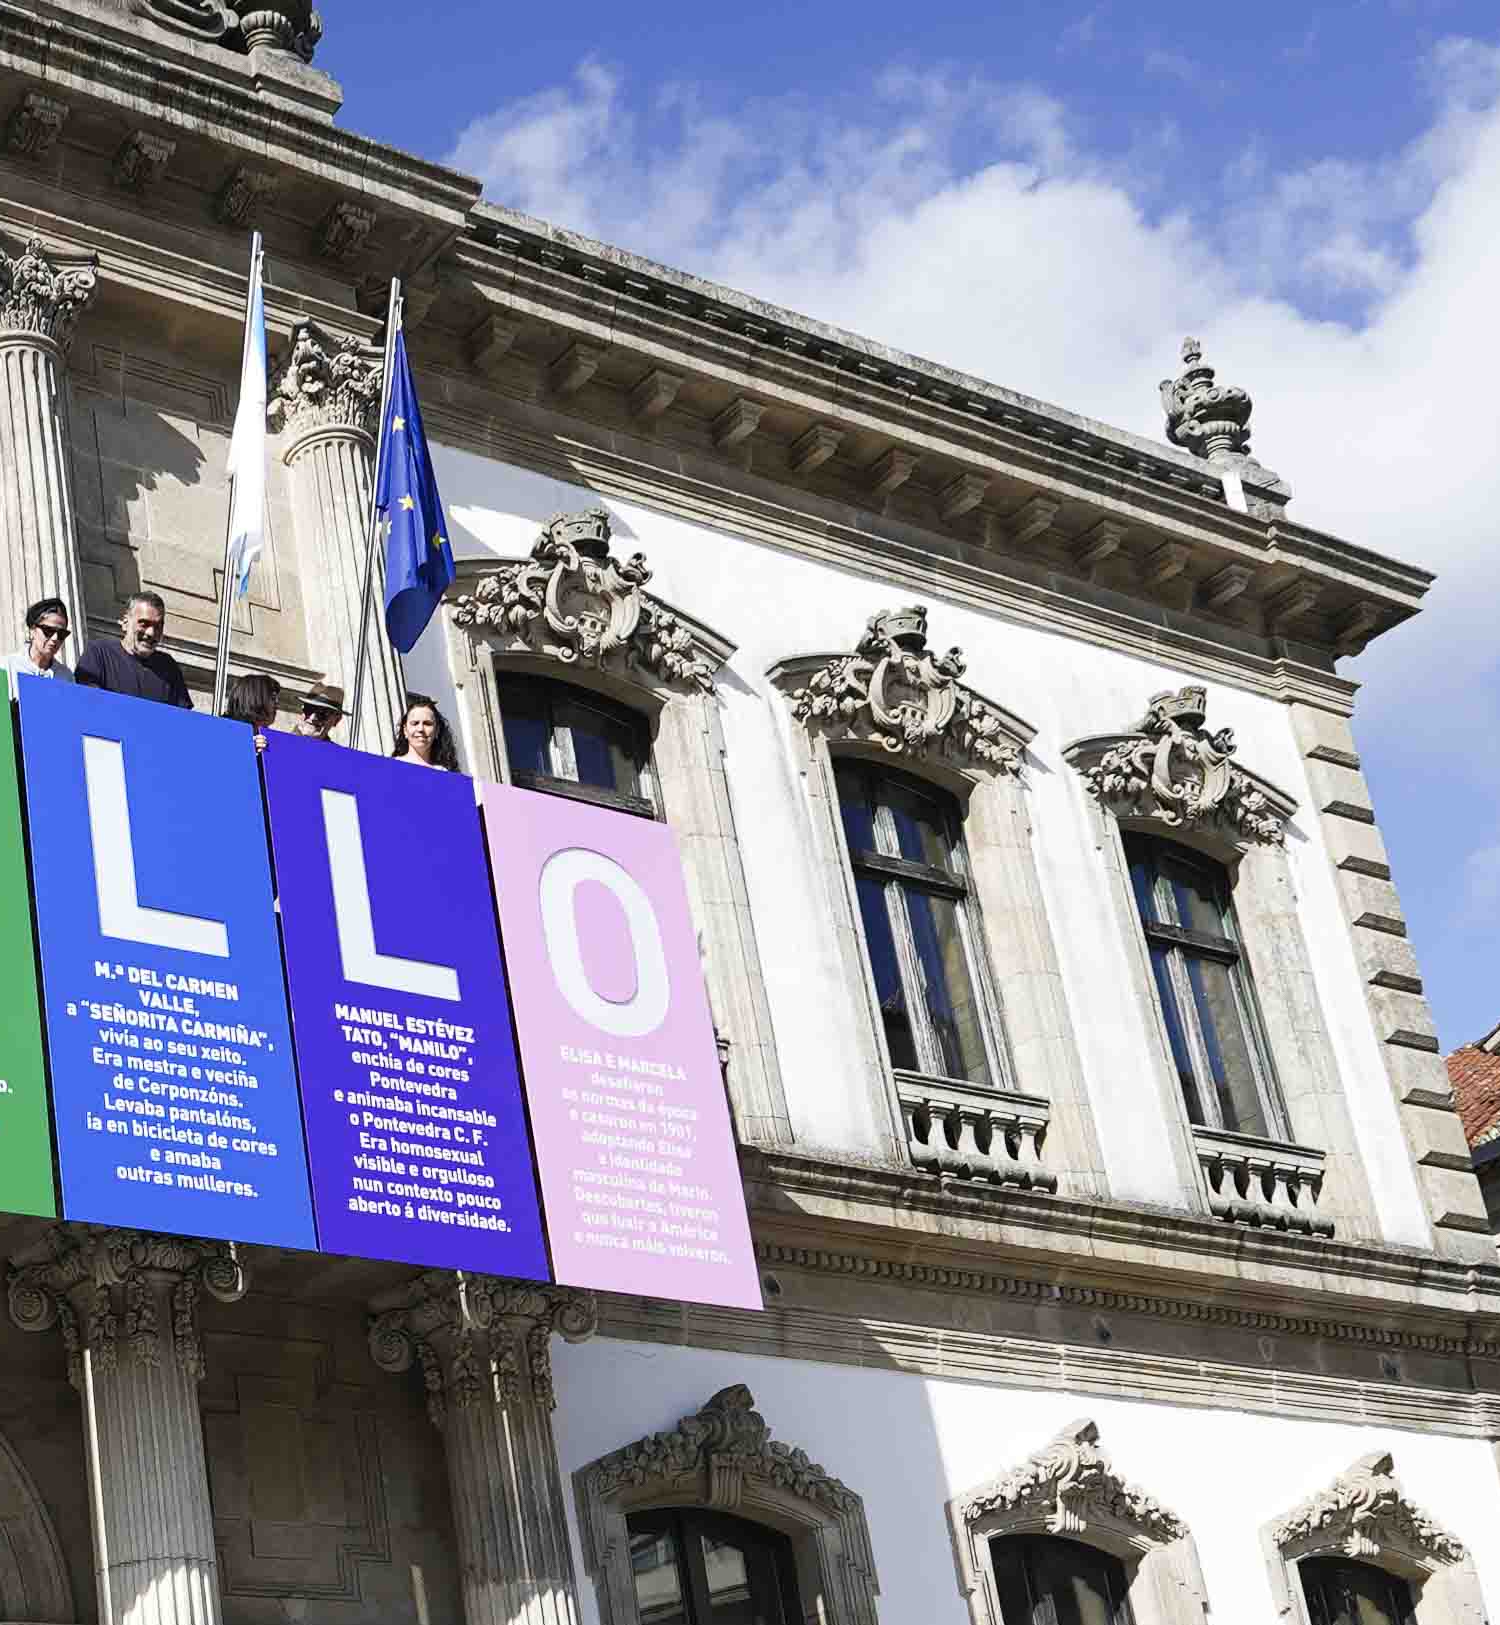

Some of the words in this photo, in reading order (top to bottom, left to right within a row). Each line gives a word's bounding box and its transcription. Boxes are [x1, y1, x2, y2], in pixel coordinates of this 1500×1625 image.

[82, 734, 230, 958] L
[320, 788, 461, 1002] L
[538, 849, 670, 1037] O
[127, 966, 163, 988] DEL
[165, 973, 239, 1001] CARMEN
[66, 1002, 77, 1017] a
[138, 989, 201, 1018] VALLE,
[334, 1003, 404, 1031] MANUEL
[405, 1016, 475, 1044] ESTÉVEZ
[341, 1025, 388, 1050] TATO,
[143, 1037, 164, 1052] ao
[167, 1041, 198, 1058] seu
[201, 1046, 247, 1066] xeito.
[92, 1047, 123, 1068] Era
[127, 1056, 188, 1078] mestra
[191, 1066, 202, 1080] e
[204, 1069, 259, 1089] veciña
[405, 1058, 425, 1075] de
[428, 1064, 470, 1083] cores
[113, 1073, 135, 1091] de
[138, 1076, 244, 1108] Cerponzóns.
[369, 1071, 458, 1101] Pontevedra
